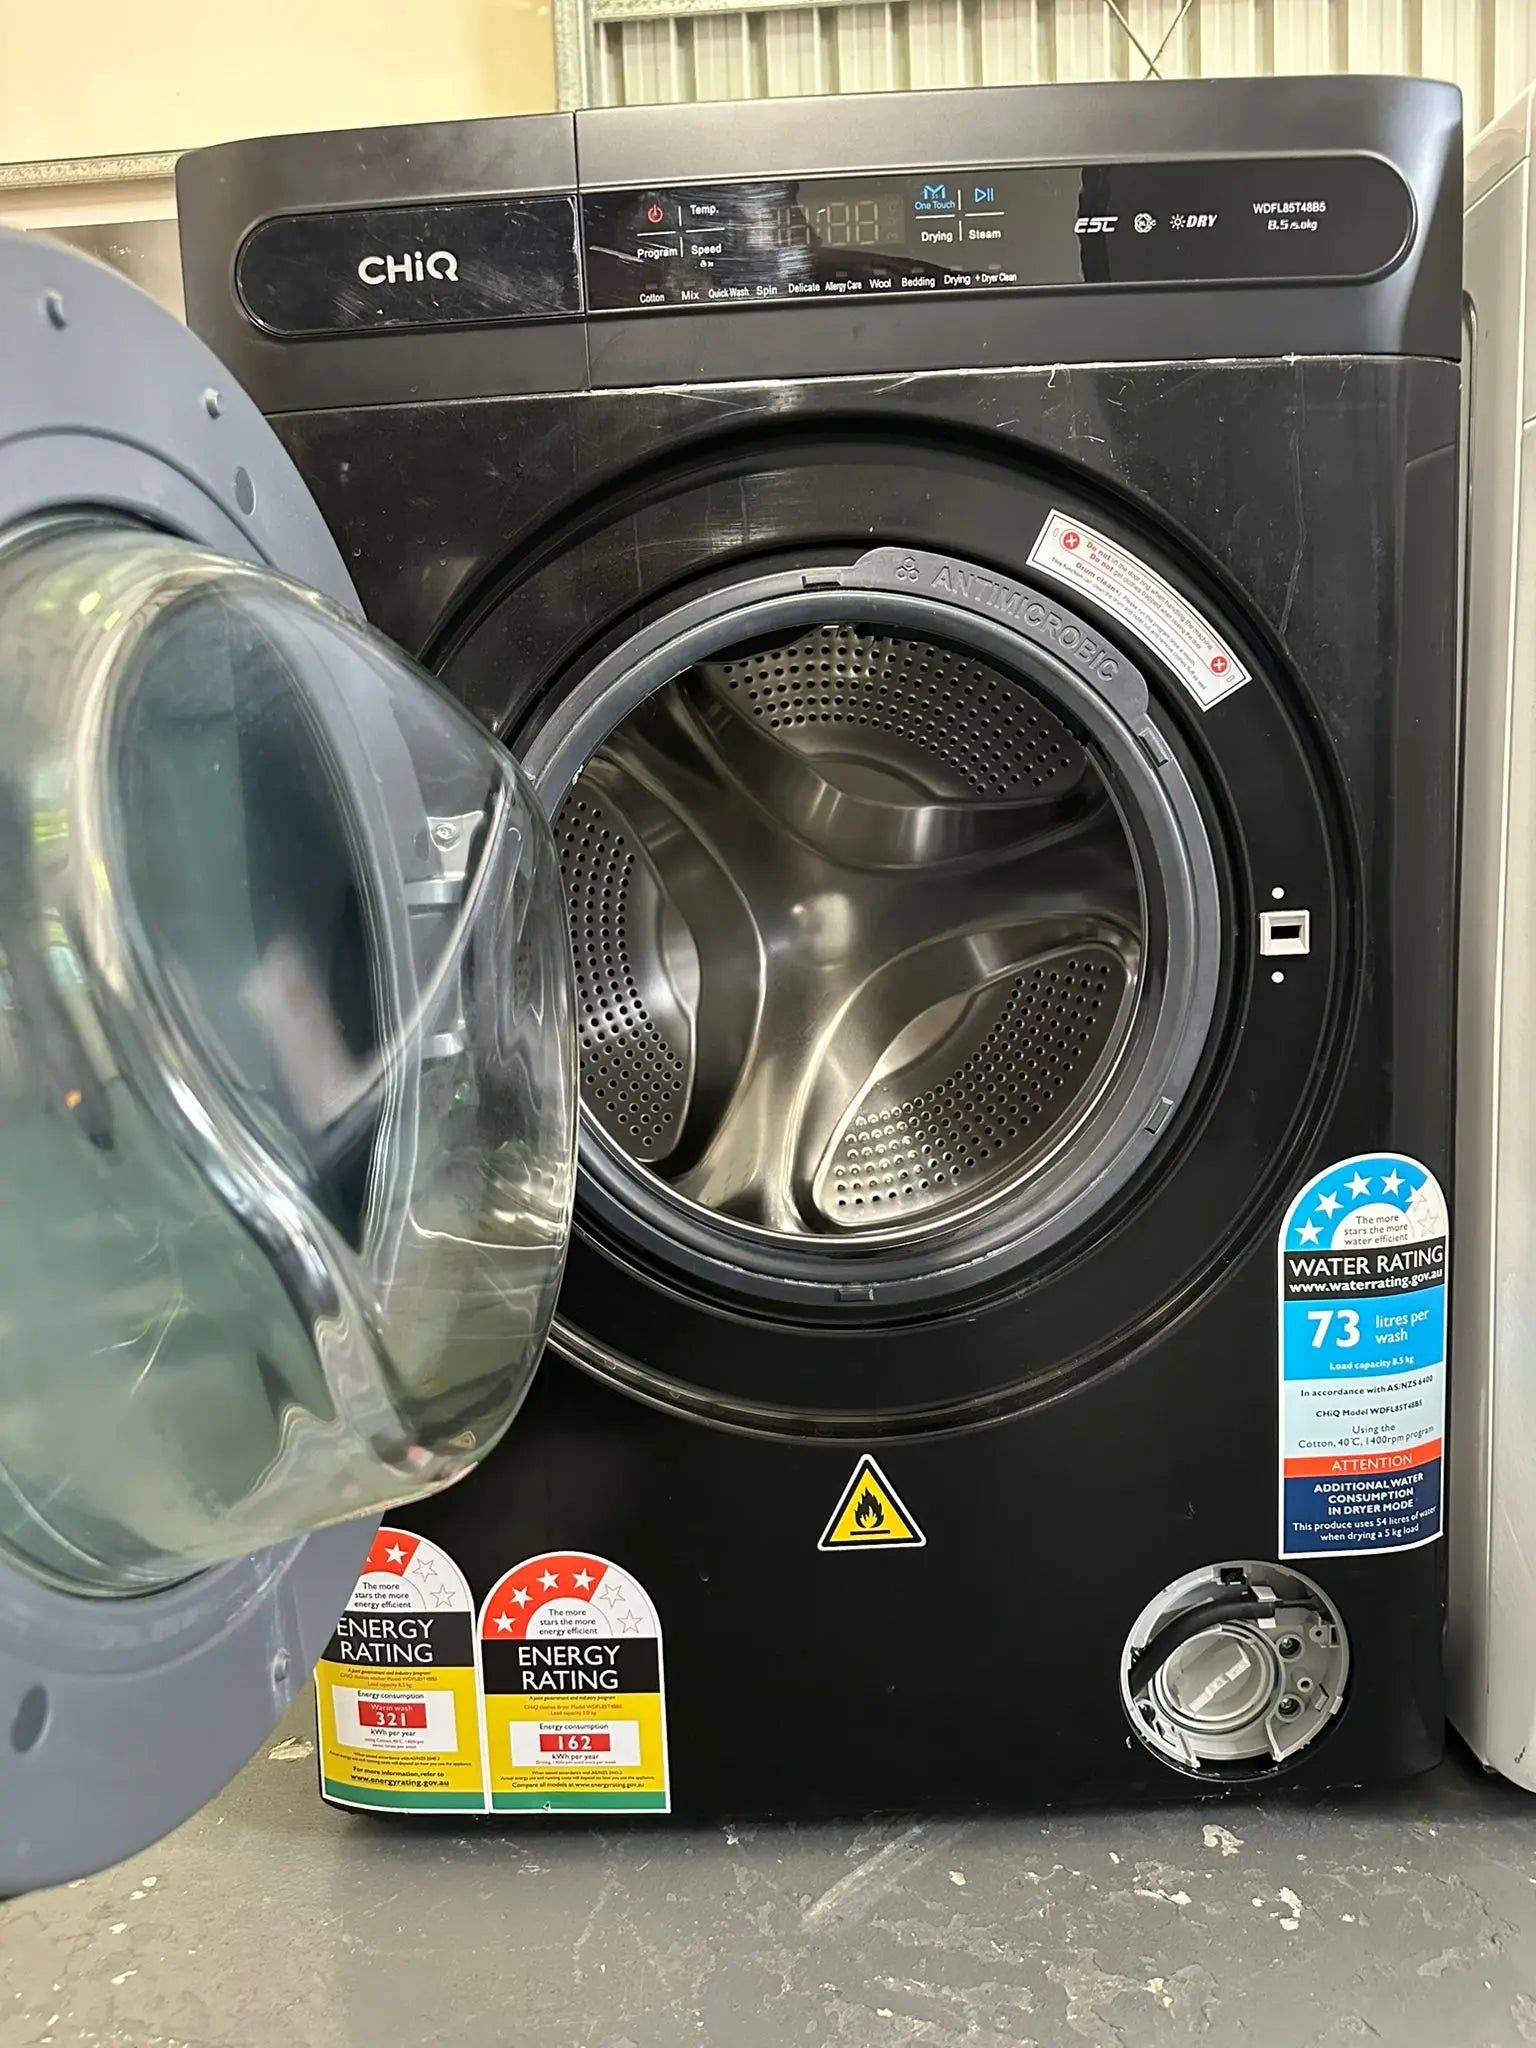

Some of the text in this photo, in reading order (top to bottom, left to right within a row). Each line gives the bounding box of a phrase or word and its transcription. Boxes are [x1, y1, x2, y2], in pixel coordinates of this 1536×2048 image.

[690, 204, 719, 215] Temp.
[915, 200, 956, 210] One Touch
[1252, 201, 1326, 214] WDFL85T48B5
[1186, 214, 1218, 228] DRY
[922, 232, 953, 243] Drying
[968, 229, 1001, 240] Steam
[637, 248, 678, 260] Program
[691, 244, 722, 256] Speed
[358, 250, 459, 285] CHiQ
[870, 278, 892, 289] Wool
[902, 276, 936, 288] Bedding
[944, 274, 970, 287] Drying
[982, 273, 999, 284] Dryer
[1000, 272, 1017, 282] Clean
[708, 288, 750, 299] Quick Wash
[756, 286, 778, 296] Spin
[788, 282, 820, 294] Delicate
[825, 280, 862, 294] Allergy Care
[640, 293, 664, 303] Cotton
[682, 290, 700, 300] Mix
[1086, 541, 1097, 552] Do
[1098, 549, 1111, 560] not
[1089, 553, 1101, 563] Do
[1100, 560, 1113, 571] not
[1075, 562, 1096, 577] Drum
[930, 564, 1120, 682] ANTIMICROBIC
[1355, 1214, 1399, 1225] The more
[1344, 1223, 1408, 1235] stars the more
[1344, 1233, 1408, 1245] water efficient
[1289, 1245, 1443, 1277] WATER RATING
[1289, 1268, 1443, 1293] www.waterrating.gov.au
[1376, 1309, 1430, 1329] litres per
[1307, 1309, 1361, 1349] 73
[1375, 1329, 1408, 1344] wash
[1329, 1361, 1355, 1371] Load
[1357, 1359, 1391, 1371] capacity
[1405, 1356, 1414, 1365] kg
[1312, 1388, 1365, 1396] accordance
[1367, 1385, 1386, 1394] with
[1316, 1410, 1341, 1418] CHiQ
[1343, 1408, 1368, 1417] Model
[1352, 1423, 1395, 1434] Using the
[1298, 1440, 1336, 1449] Cotton,
[1365, 1435, 1405, 1446] 1400rpm
[1406, 1425, 1434, 1441] program
[1331, 1453, 1413, 1471] ATTENTION
[1313, 1472, 1424, 1493] ADDITIONAL WATER
[1328, 1488, 1414, 1503] CONSUMPTION
[1328, 1499, 1414, 1515] IN DRYER MODE
[1292, 1506, 1437, 1533] This produce uses 54 litres of water
[1321, 1533, 1345, 1541] when
[1347, 1530, 1375, 1541] drying
[1385, 1529, 1390, 1537] 5
[1392, 1528, 1402, 1539] kg
[1403, 1524, 1419, 1534] load
[362, 1582, 377, 1590] The
[337, 1617, 434, 1639] ENERGY
[567, 1627, 598, 1635] efficient
[340, 1641, 433, 1662] RATING
[518, 1645, 621, 1667] ENERGY
[522, 1669, 618, 1690] RATING
[357, 1690, 424, 1700] Energy consumption
[376, 1712, 406, 1726] 321
[539, 1723, 608, 1731] Energy consumption
[558, 1736, 592, 1750] 162
[351, 1774, 449, 1787] www.energyrating.gov.au
